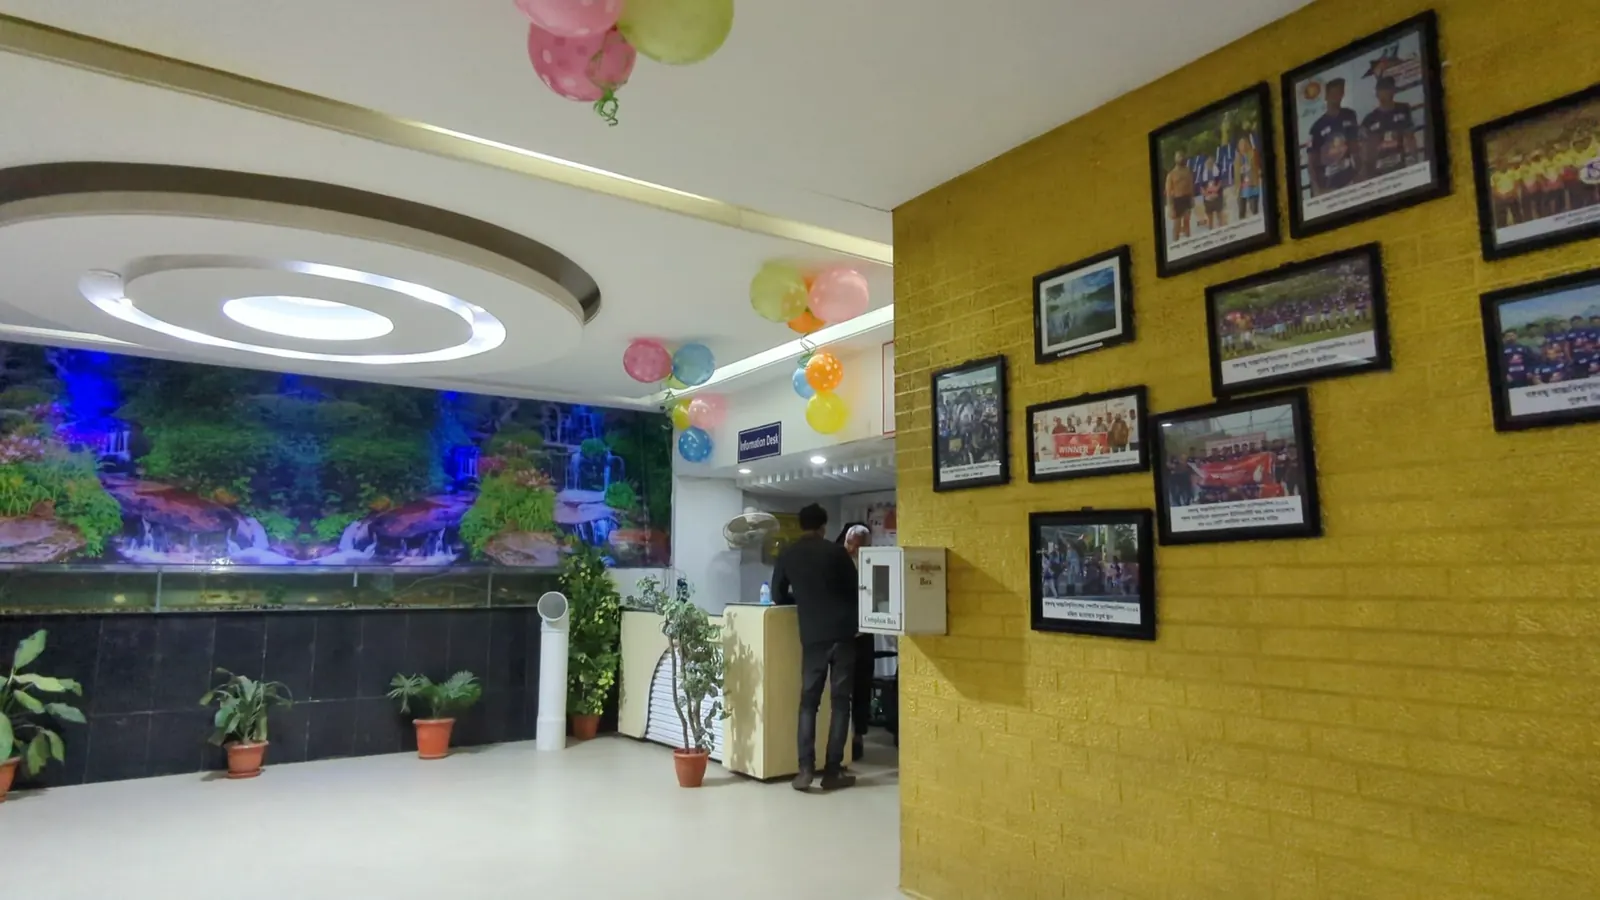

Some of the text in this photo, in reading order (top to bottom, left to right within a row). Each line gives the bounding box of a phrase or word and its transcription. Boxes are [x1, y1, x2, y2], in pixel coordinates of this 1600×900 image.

[740, 433, 779, 451] Information Desk
[1059, 445, 1088, 454] WINNER
[919, 577, 932, 586] Box
